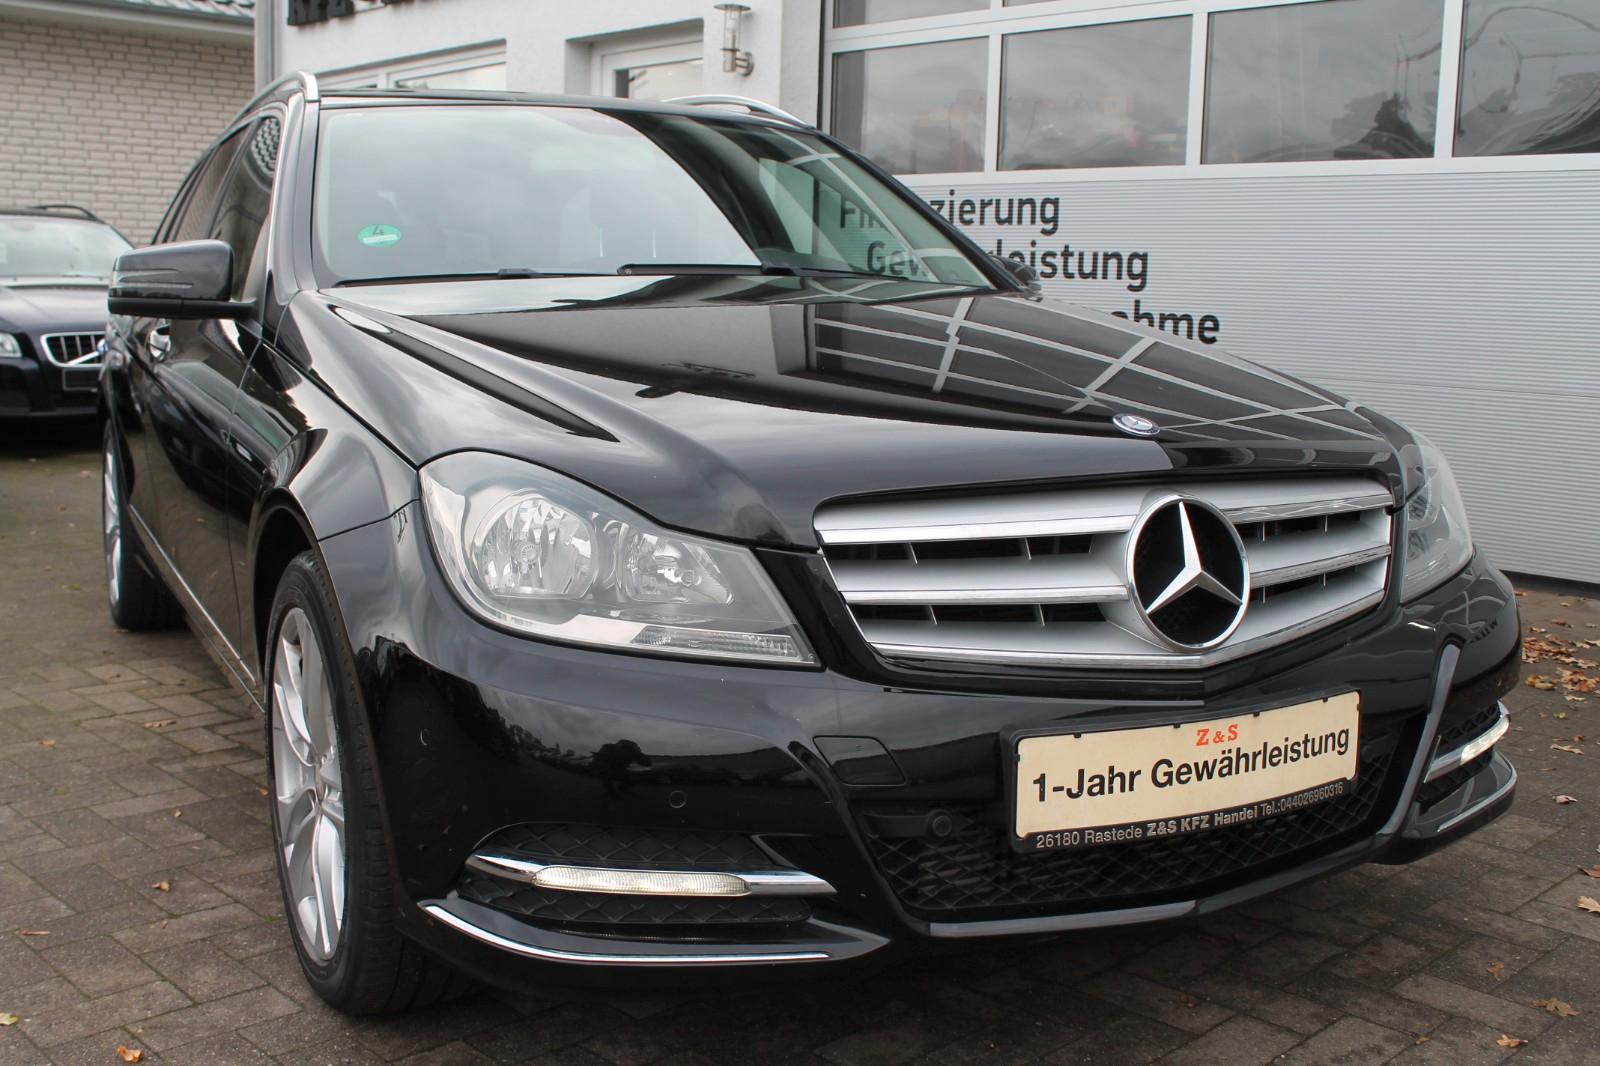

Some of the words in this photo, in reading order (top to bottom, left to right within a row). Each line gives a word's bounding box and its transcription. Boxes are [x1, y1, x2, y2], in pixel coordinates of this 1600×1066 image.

[1032, 765, 1141, 802] 1-Jahr
[1151, 728, 1349, 788] Gewährleistung
[1036, 831, 1080, 849] 26180
[1084, 825, 1142, 844] Rastede
[1147, 820, 1177, 837] Z&S
[1181, 815, 1210, 833] KFZ
[1214, 806, 1258, 826] Handel
